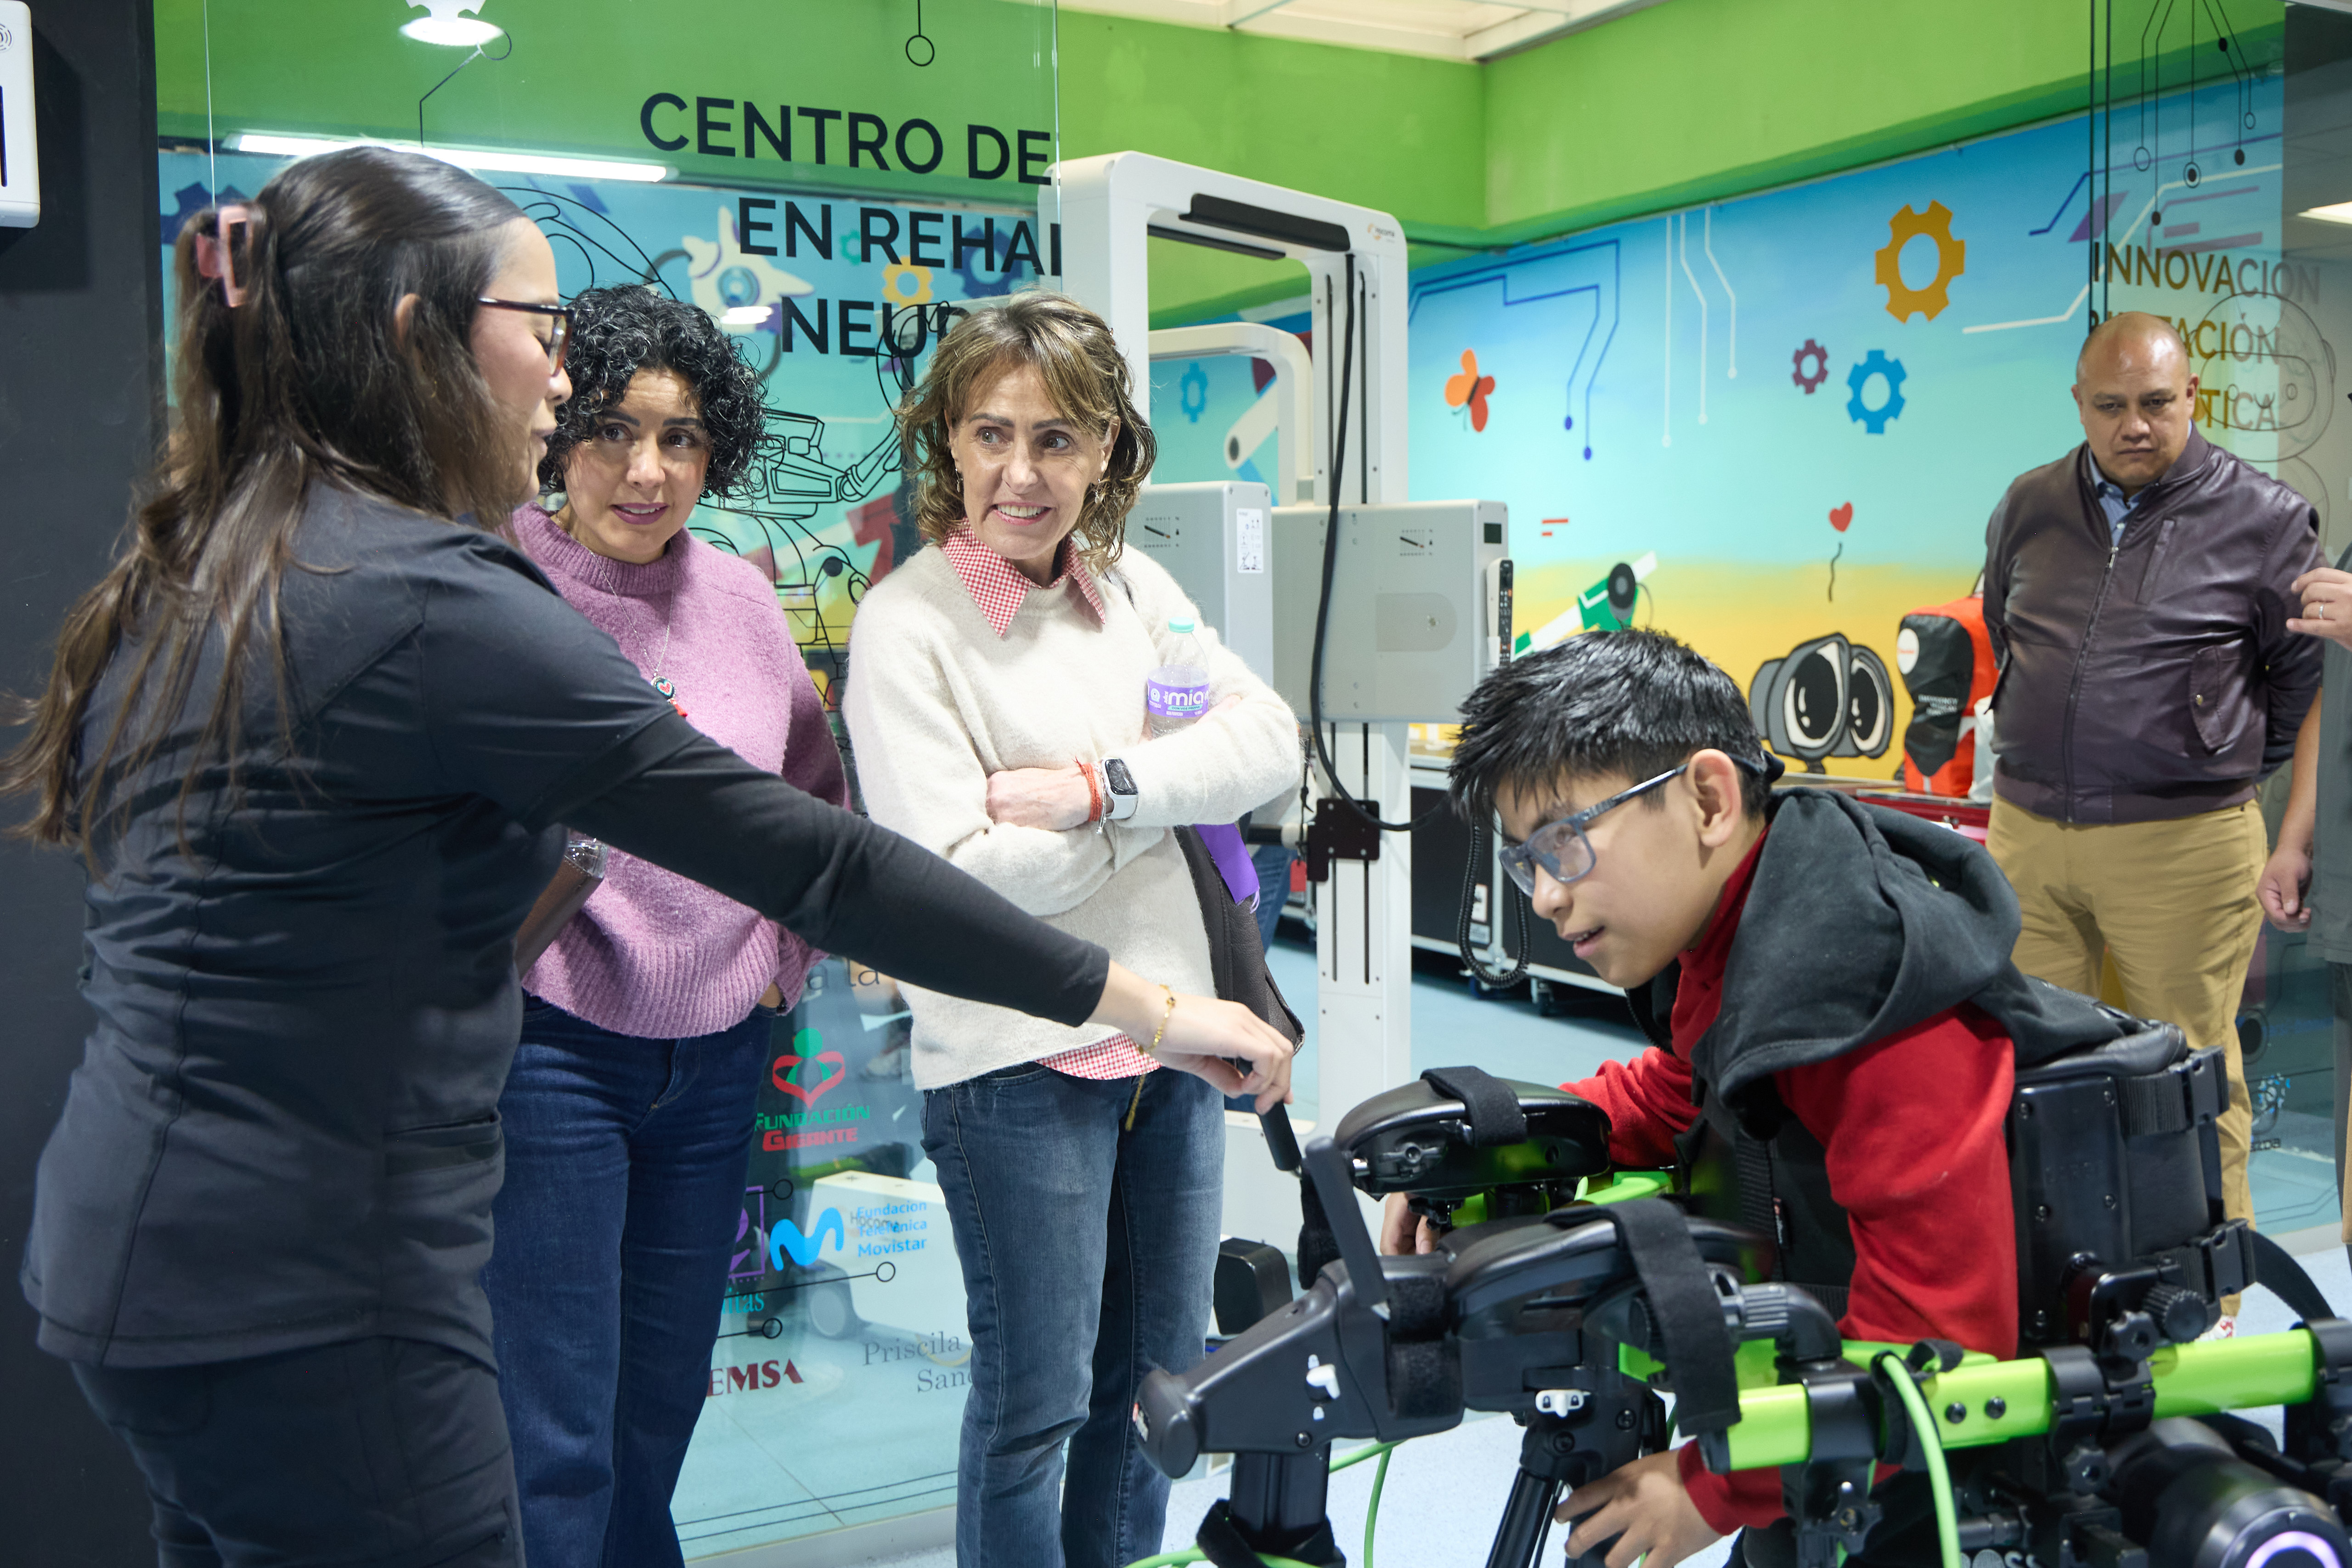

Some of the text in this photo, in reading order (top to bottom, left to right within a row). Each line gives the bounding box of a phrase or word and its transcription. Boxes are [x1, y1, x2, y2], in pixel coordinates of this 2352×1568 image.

[640, 92, 1052, 186] CENTRO DE
[739, 197, 1061, 276] EN REHA
[754, 1103, 870, 1132] FUNDACIÓN
[858, 1238, 927, 1258] Movistar
[863, 1331, 961, 1367] Priscila
